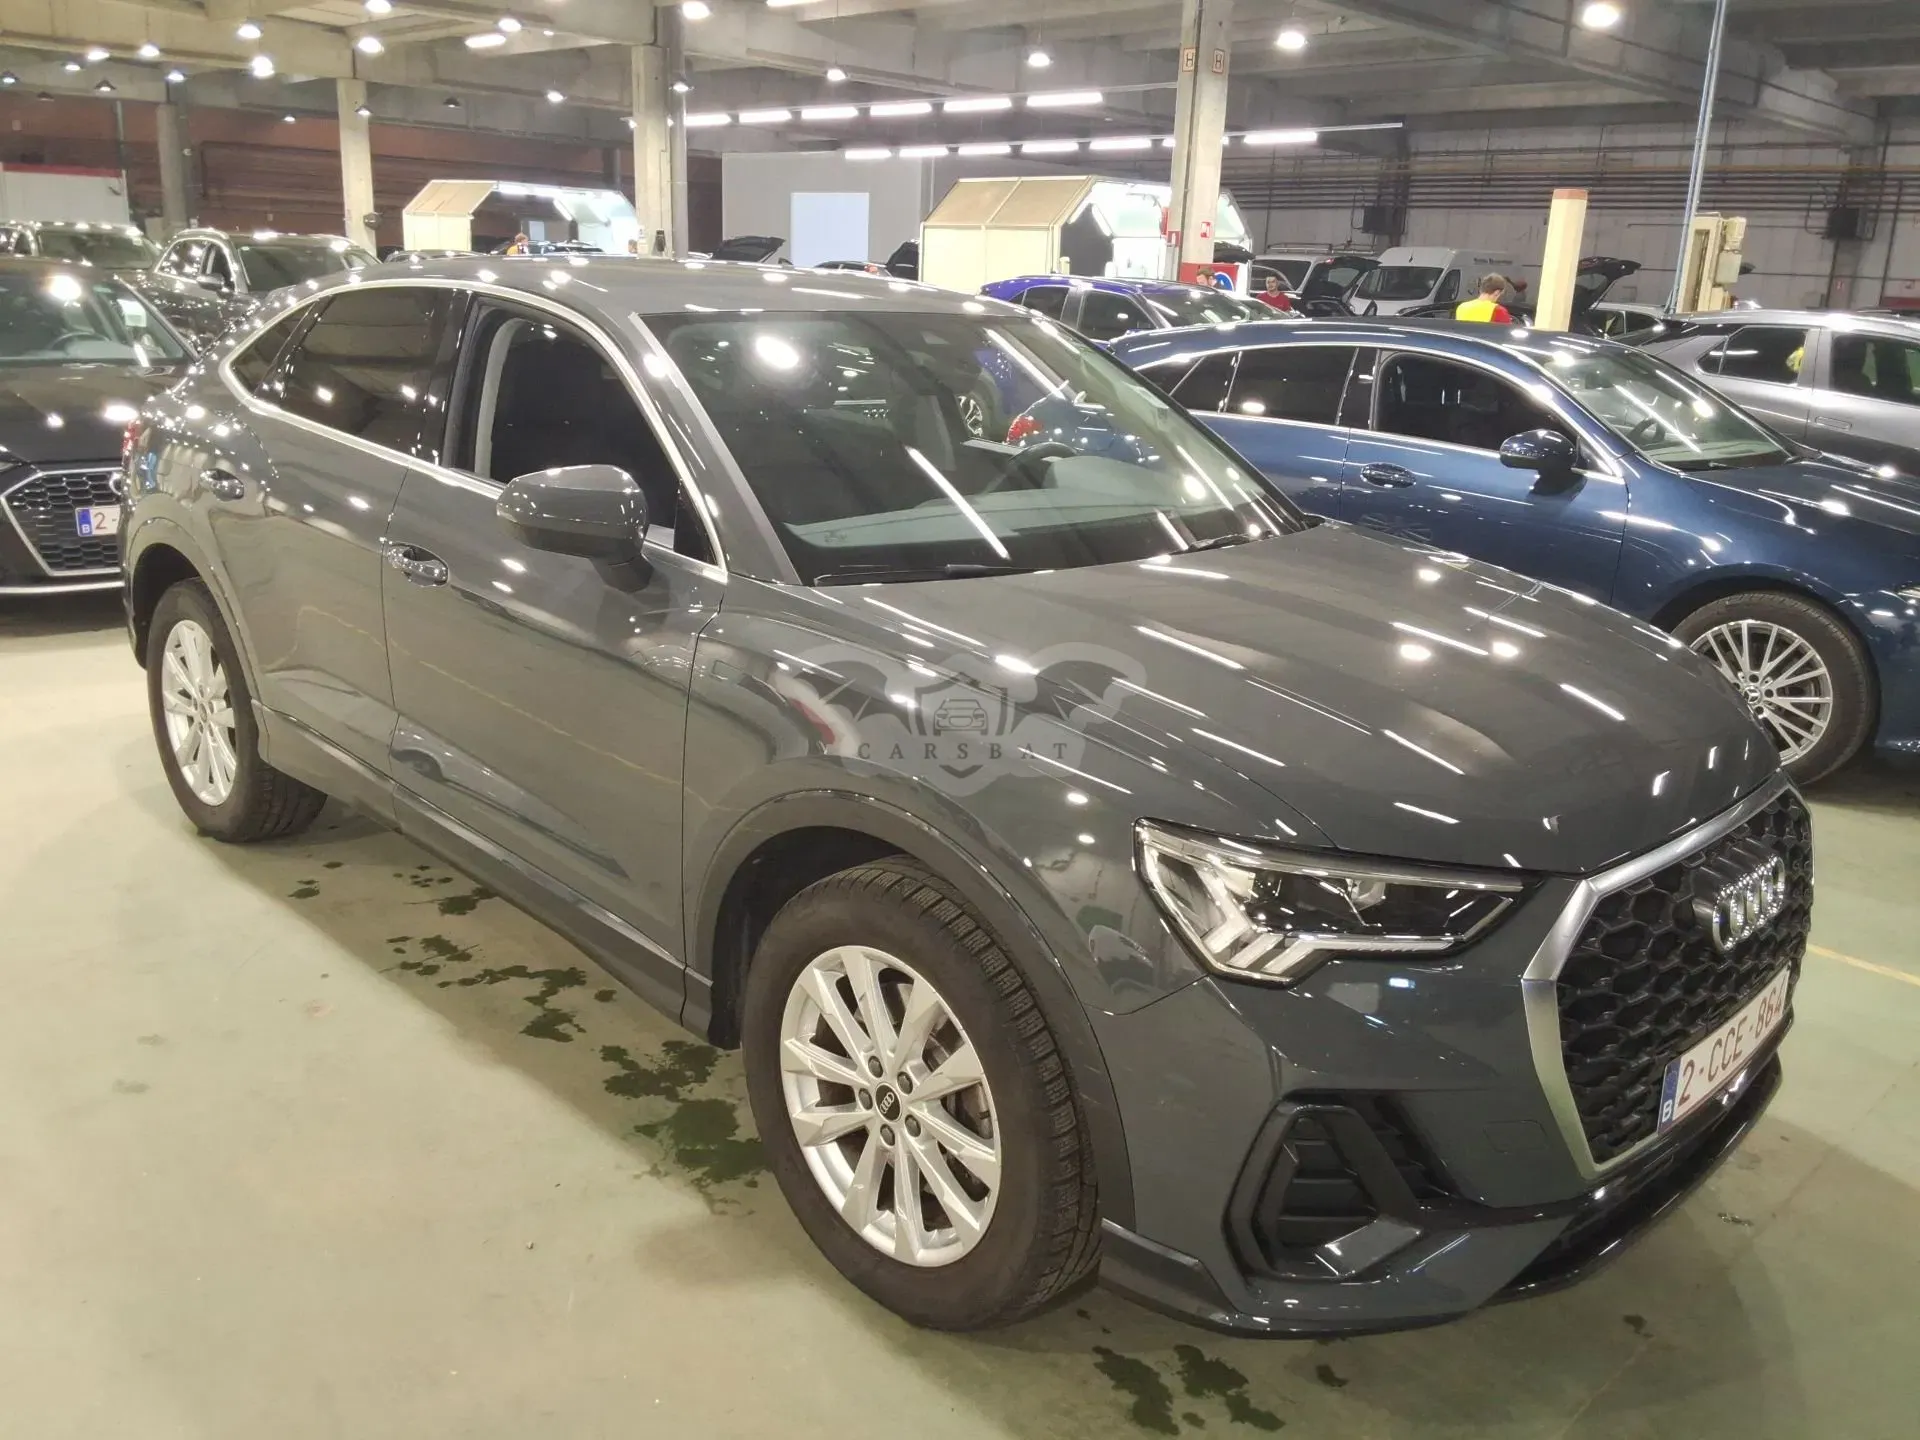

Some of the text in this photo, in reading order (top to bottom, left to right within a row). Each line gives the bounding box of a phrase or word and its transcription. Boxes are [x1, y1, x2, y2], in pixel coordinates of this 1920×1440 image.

[1186, 53, 1193, 67] H
[1215, 54, 1222, 68] H
[82, 524, 90, 533] B
[1662, 1099, 1673, 1122] B
